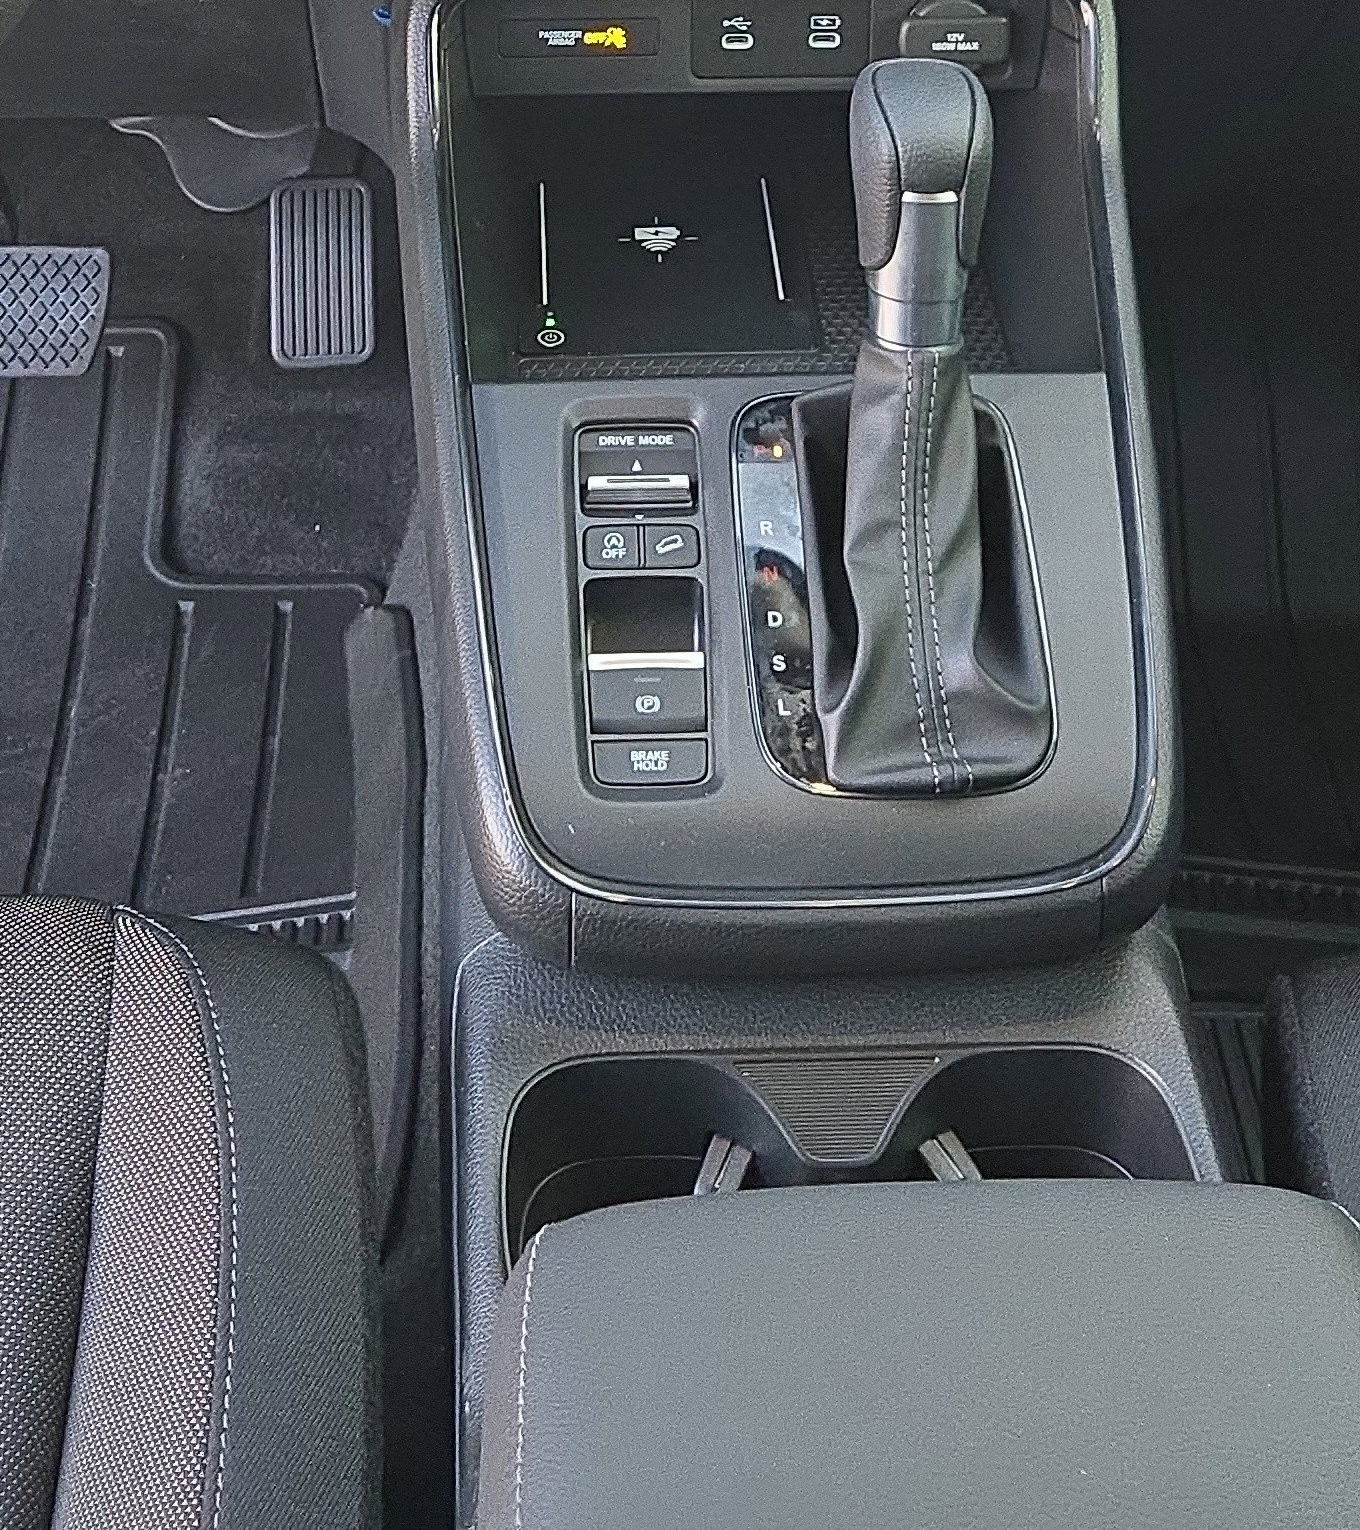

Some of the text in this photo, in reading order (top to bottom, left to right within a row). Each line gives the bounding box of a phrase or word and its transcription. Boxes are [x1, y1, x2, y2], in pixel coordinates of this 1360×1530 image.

[539, 30, 582, 39] PASSENGER
[957, 41, 979, 51] MAX
[599, 434, 674, 447] DRIVE MODE
[759, 520, 774, 536] R
[601, 546, 627, 560] OFF
[767, 610, 783, 628] D
[772, 654, 786, 672] S
[778, 699, 791, 716] L
[630, 750, 670, 762] BRAKE
[633, 759, 668, 771] HOLD
